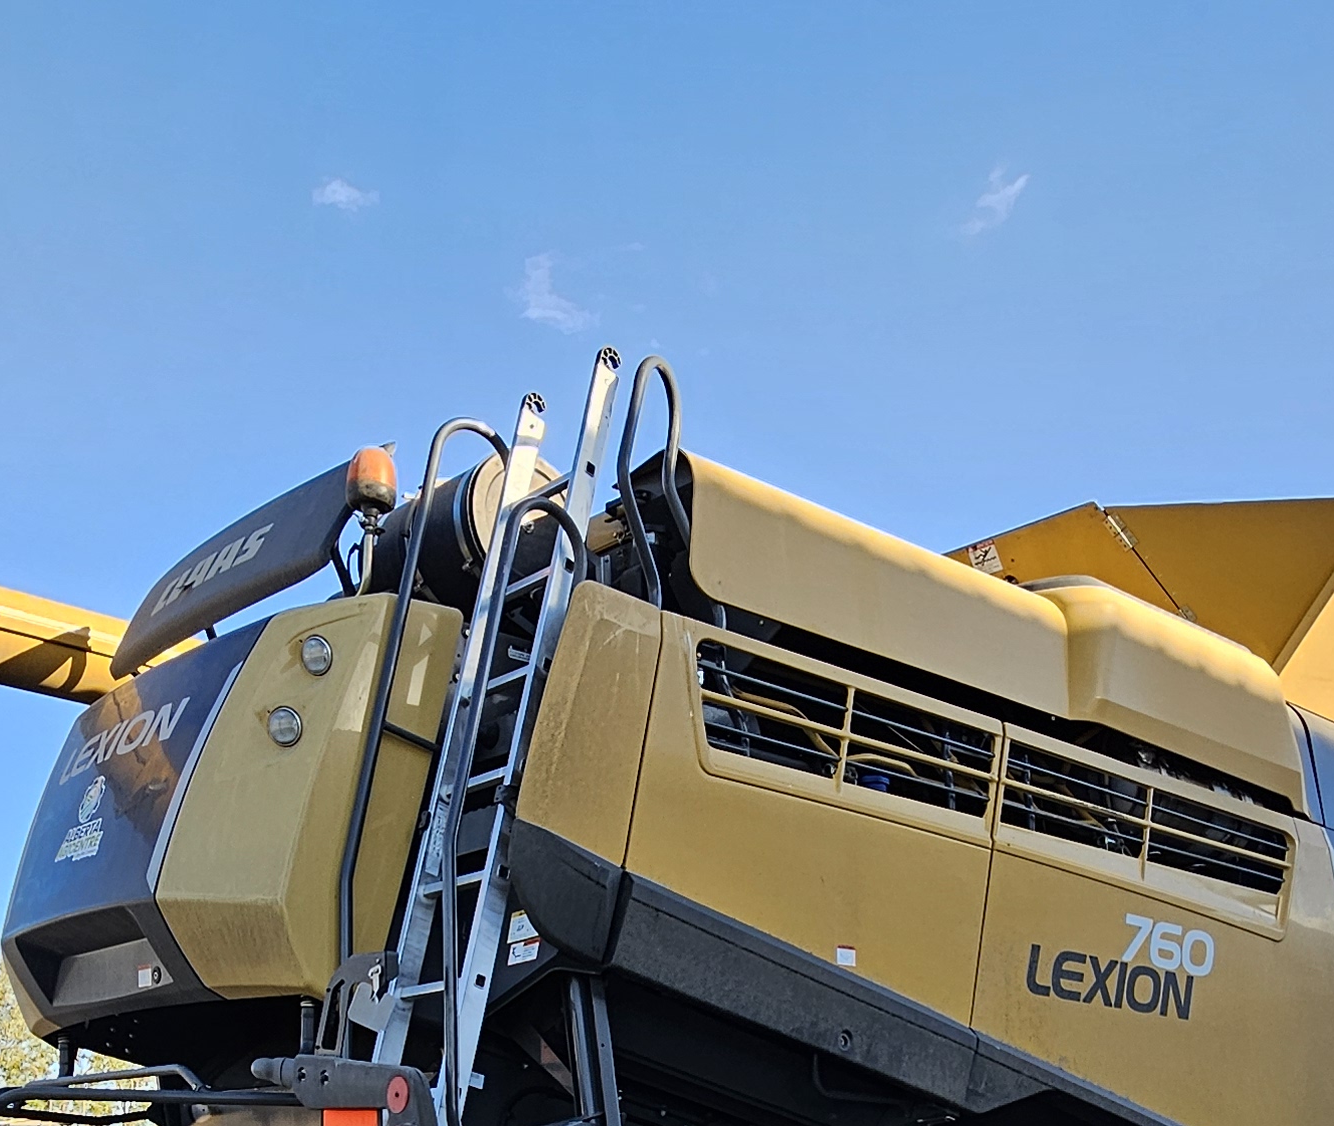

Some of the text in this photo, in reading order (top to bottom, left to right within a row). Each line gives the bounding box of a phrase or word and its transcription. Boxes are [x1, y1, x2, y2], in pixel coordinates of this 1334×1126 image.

[151, 523, 274, 617] CLAAS
[59, 696, 190, 786] LEXION
[1026, 943, 1194, 1020] LEXION
[1121, 913, 1215, 977] 760
